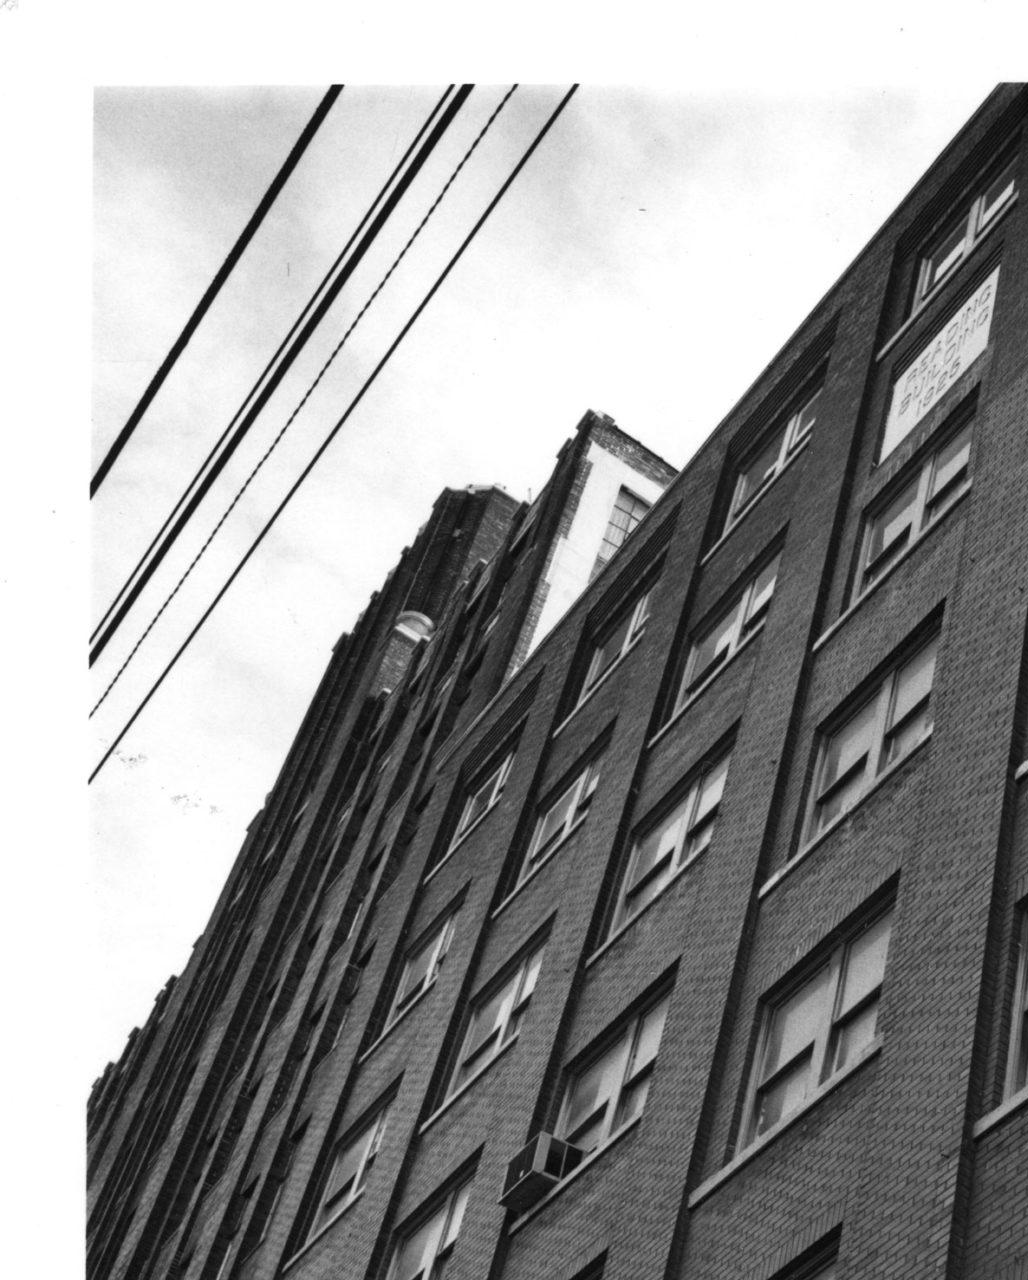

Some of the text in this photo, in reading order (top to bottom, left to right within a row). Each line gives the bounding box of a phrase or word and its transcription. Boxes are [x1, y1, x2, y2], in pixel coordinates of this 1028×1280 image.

[898, 306, 990, 417] BUILDING
[904, 284, 992, 393] READING
[916, 356, 961, 418] 1925
